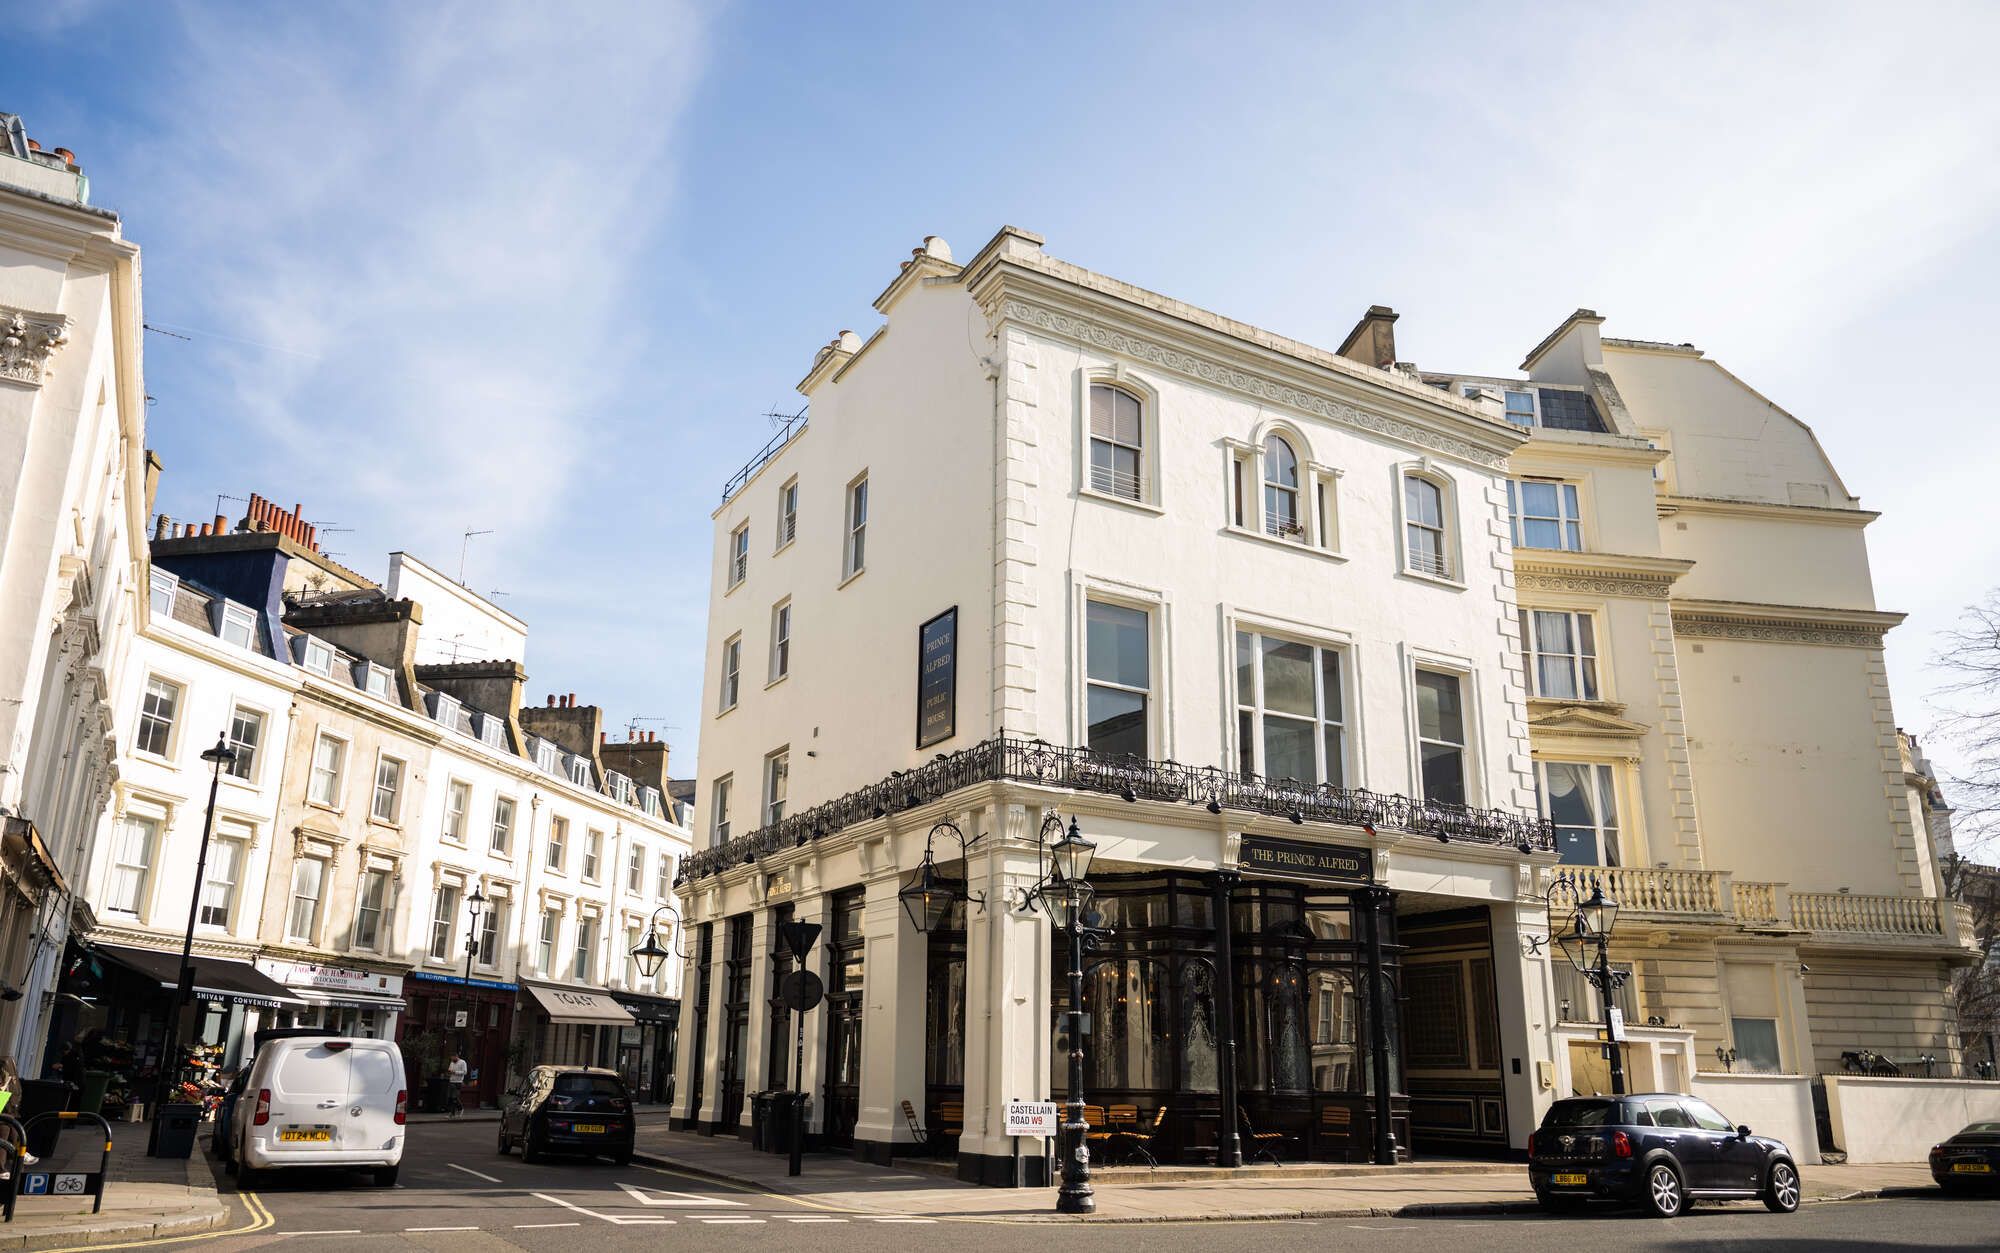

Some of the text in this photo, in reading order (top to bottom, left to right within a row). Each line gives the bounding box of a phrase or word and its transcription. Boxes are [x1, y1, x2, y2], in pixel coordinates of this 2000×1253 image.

[926, 633, 951, 653] PRINCE
[925, 654, 951, 673] ALFRED
[926, 691, 947, 709] PUBLIC
[926, 710, 946, 727] HOUSE
[1252, 848, 1359, 871] THE PRINCE ALFRED
[196, 992, 282, 1009] SHIVAM CONVENIENCE
[553, 992, 599, 1008] TOAST
[1010, 1105, 1053, 1115] CASTELLAIN
[1010, 1115, 1043, 1126] ROAD W9
[28, 1175, 45, 1193] P
